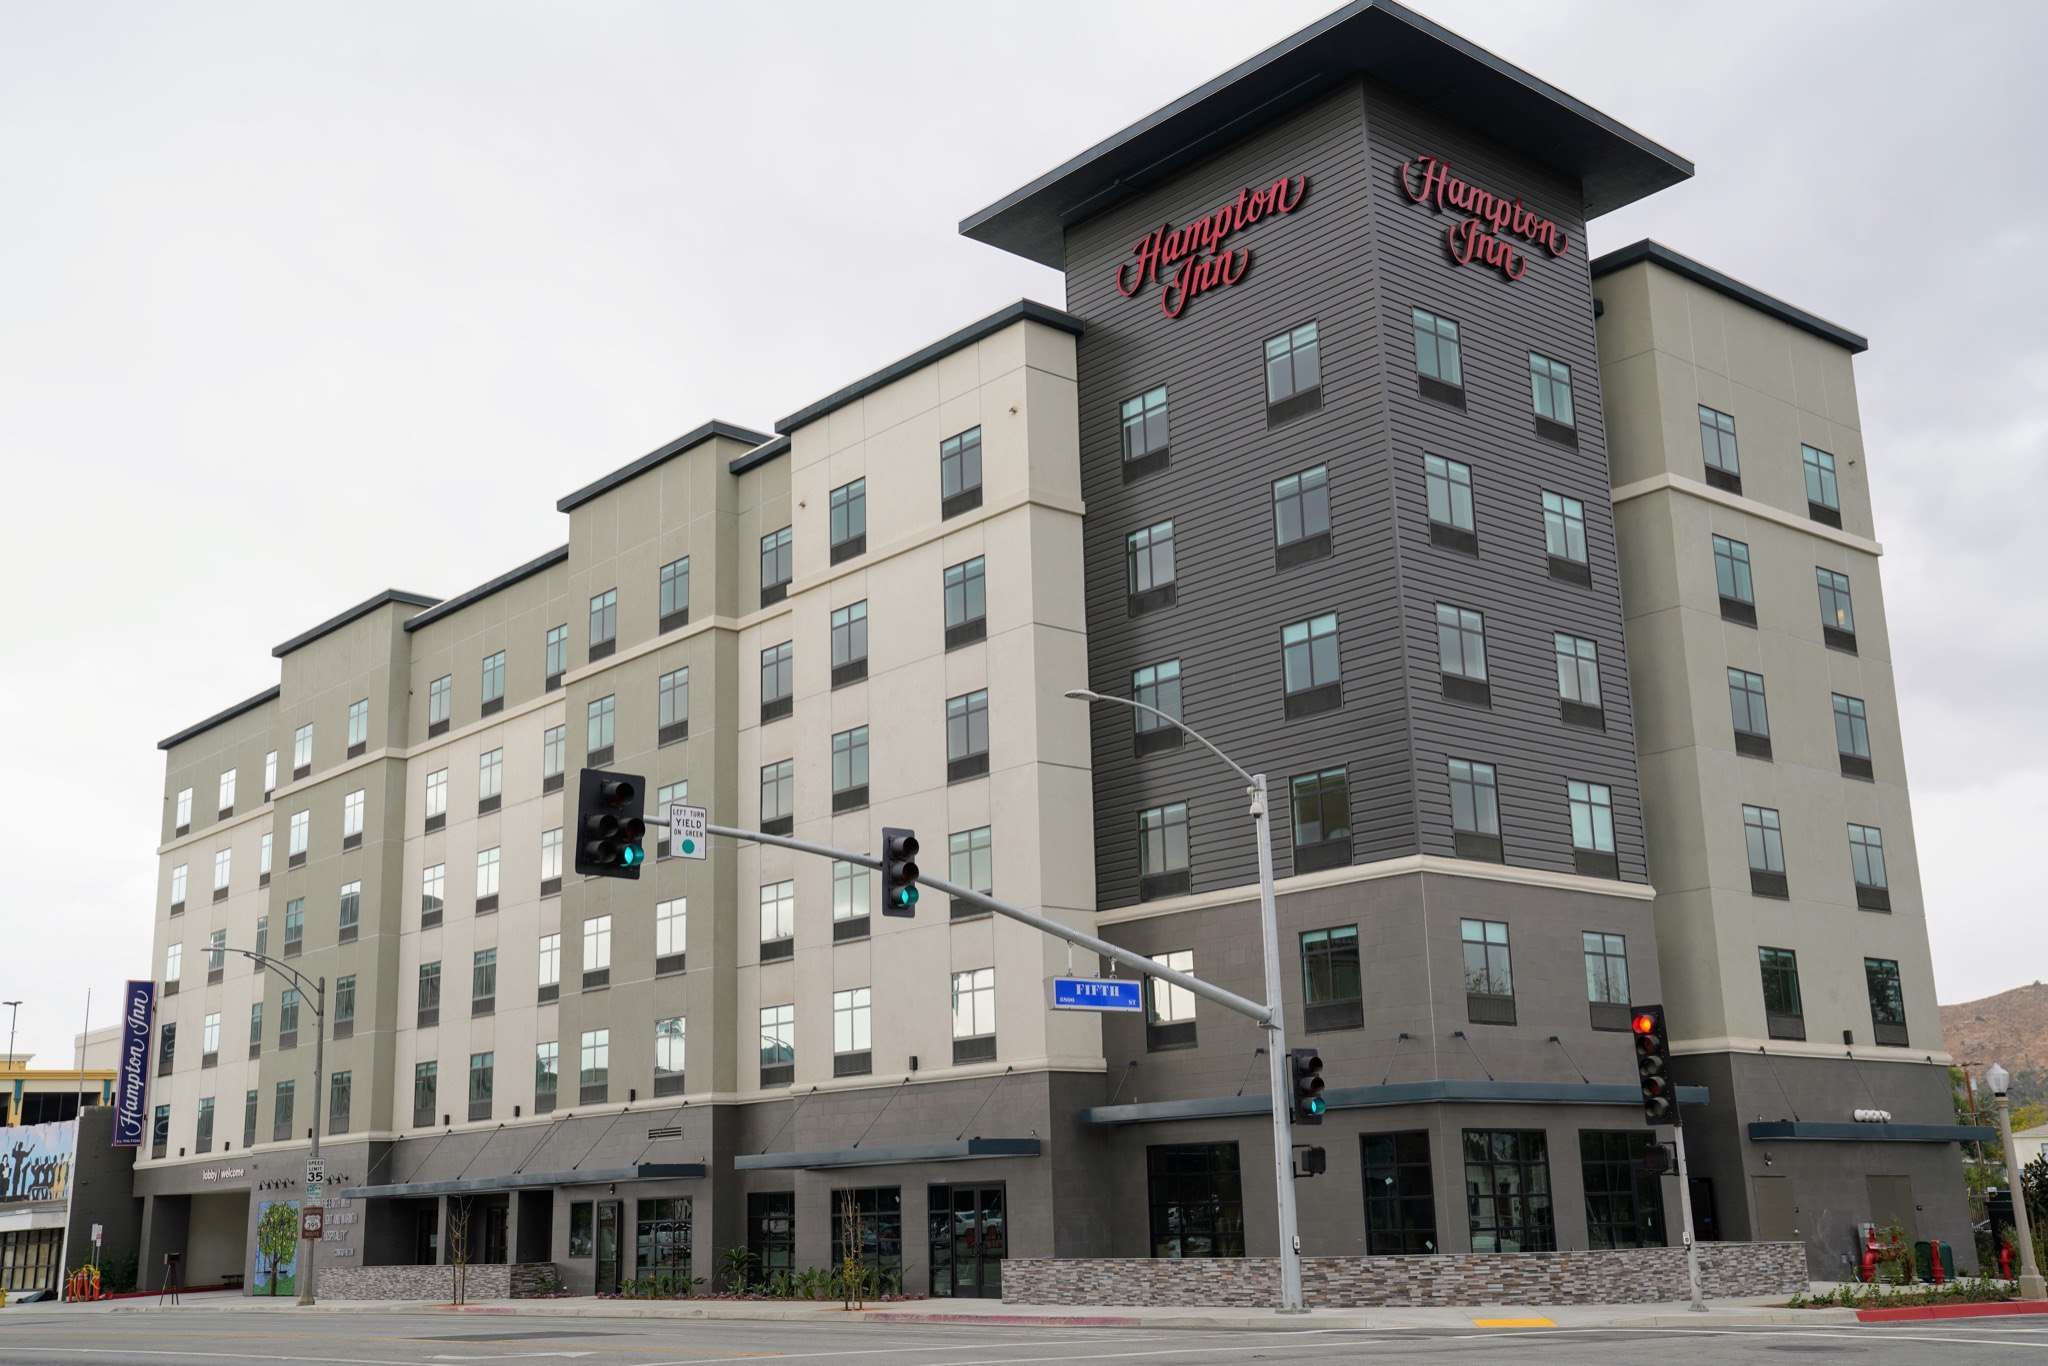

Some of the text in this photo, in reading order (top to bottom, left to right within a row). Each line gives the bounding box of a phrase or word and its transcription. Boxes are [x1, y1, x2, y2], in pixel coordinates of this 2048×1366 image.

[1403, 155, 1569, 257] Hampton
[1116, 174, 1306, 298] Hampton
[1448, 217, 1526, 281] Inn
[1161, 247, 1250, 319] Inn
[676, 818, 702, 828] YIELD
[1075, 983, 1120, 997] FIFTH
[120, 990, 149, 1136] Hampton Inn
[202, 1169, 217, 1182] lobby
[220, 1166, 245, 1179] welcome
[307, 1171, 323, 1182] 35
[306, 1222, 319, 1230] 395
